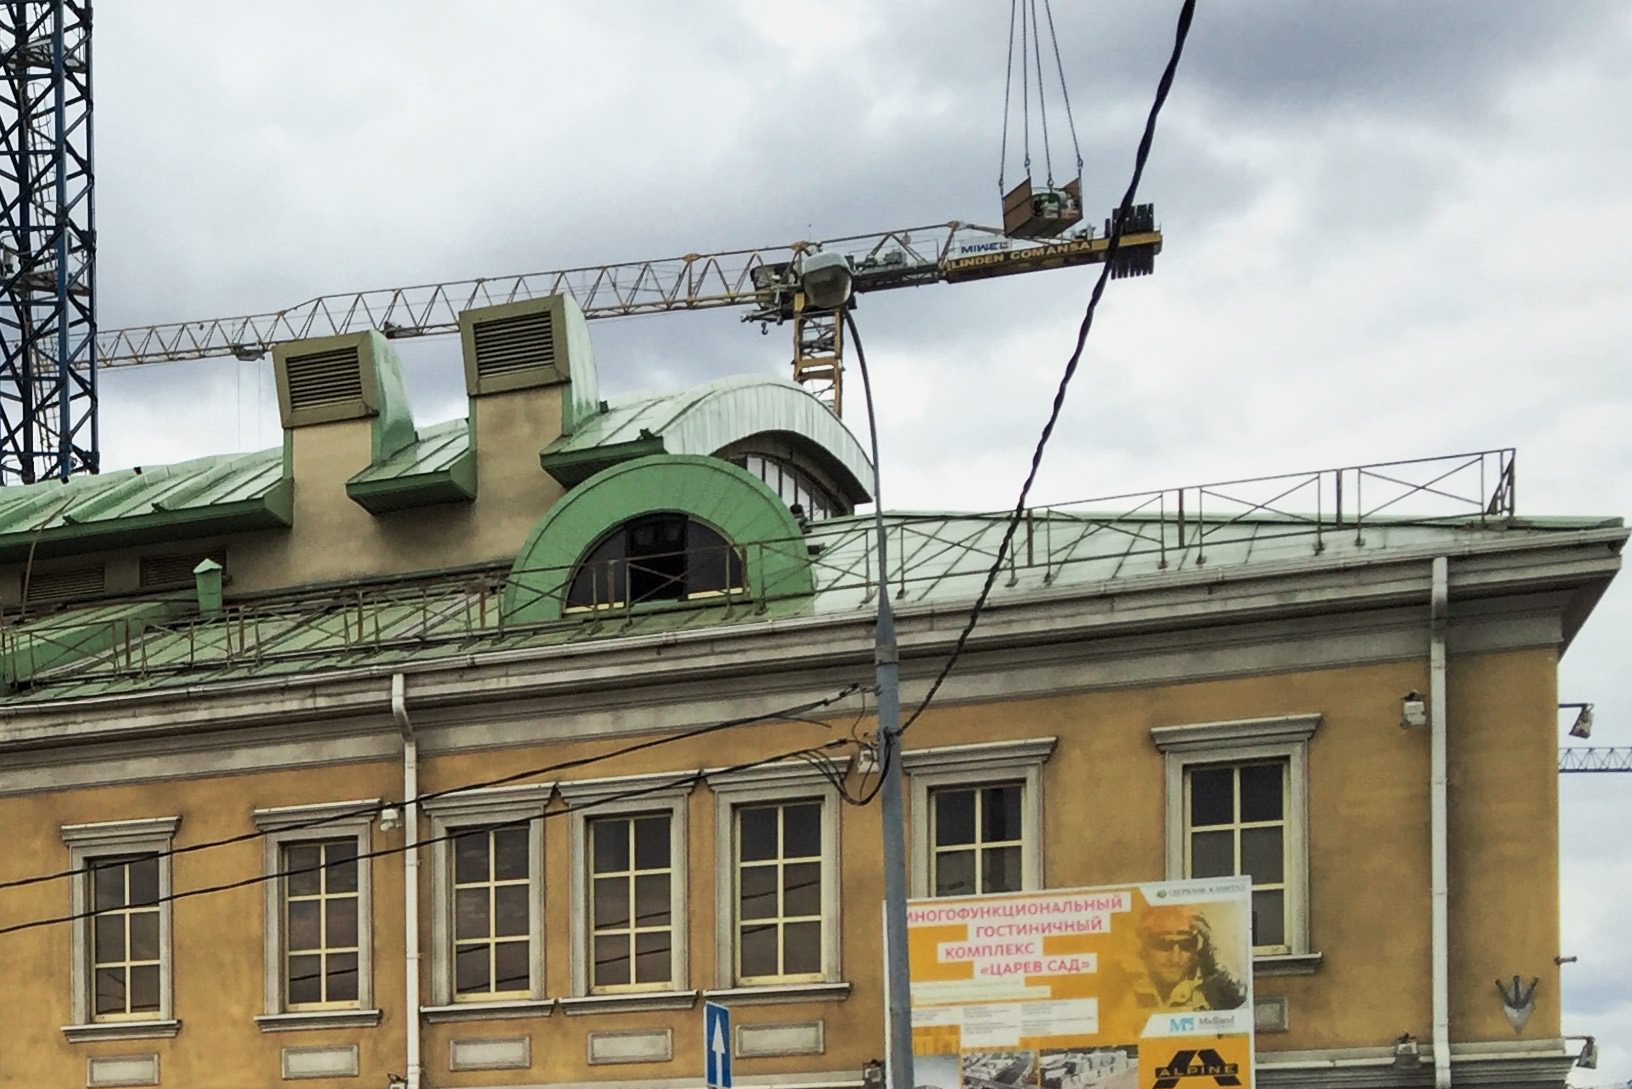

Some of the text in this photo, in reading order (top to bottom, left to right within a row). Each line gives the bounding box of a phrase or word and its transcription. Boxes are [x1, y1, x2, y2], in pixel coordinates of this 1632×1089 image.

[952, 241, 1091, 269] LINDEN COMANSA
[976, 917, 1103, 938] ГОСТИНИЧНЫЙ
[945, 942, 1035, 959] КОМПЛЕКС
[980, 958, 1090, 976] «ЦАРЕВ САД»
[1159, 1064, 1236, 1077] ALPINE
